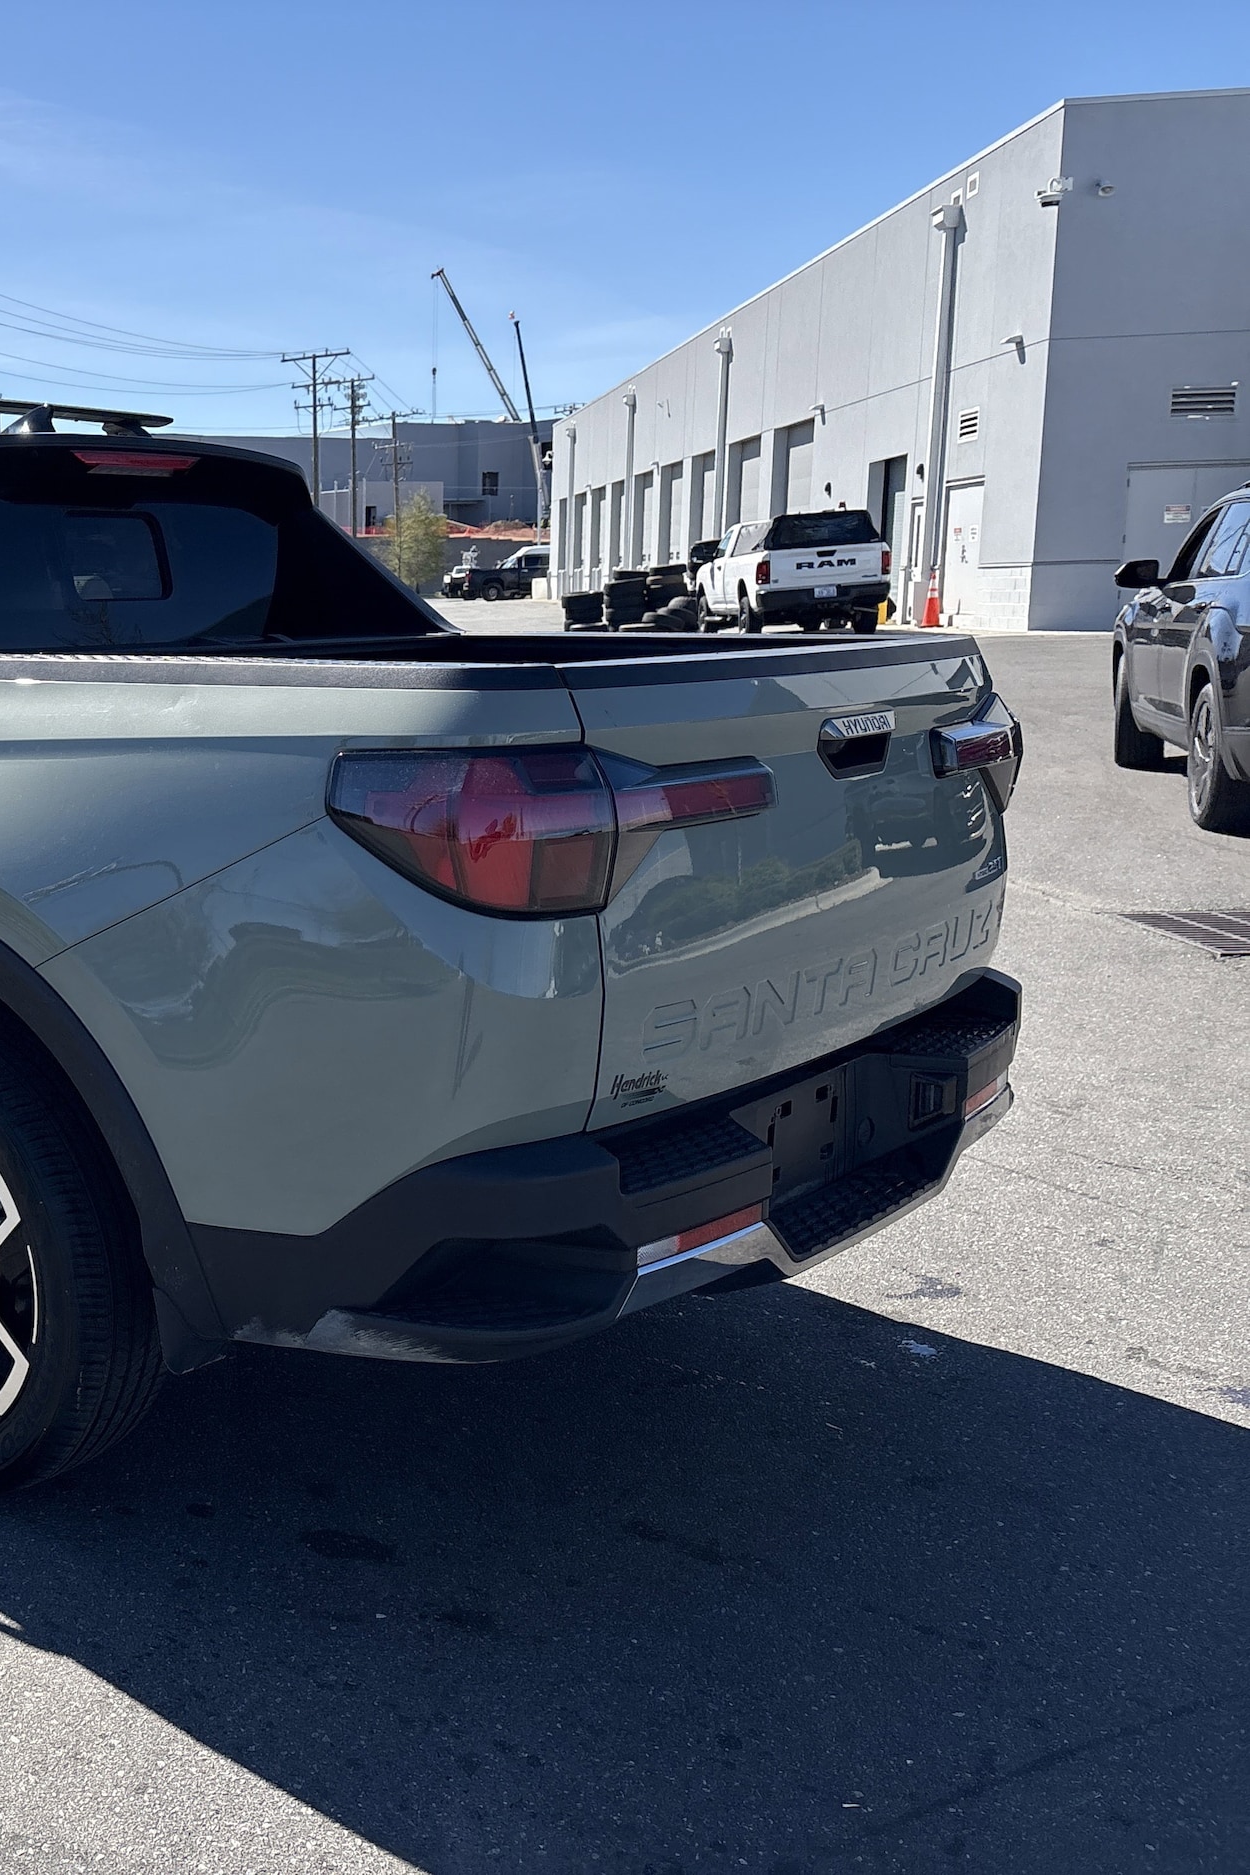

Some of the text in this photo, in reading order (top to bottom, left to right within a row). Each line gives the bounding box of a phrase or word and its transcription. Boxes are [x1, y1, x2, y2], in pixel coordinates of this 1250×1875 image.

[796, 558, 856, 570] RAM
[842, 714, 891, 735] HYUNDAI
[643, 898, 994, 1062] SANTA CRUZ
[610, 1069, 662, 1100] Hendrick
